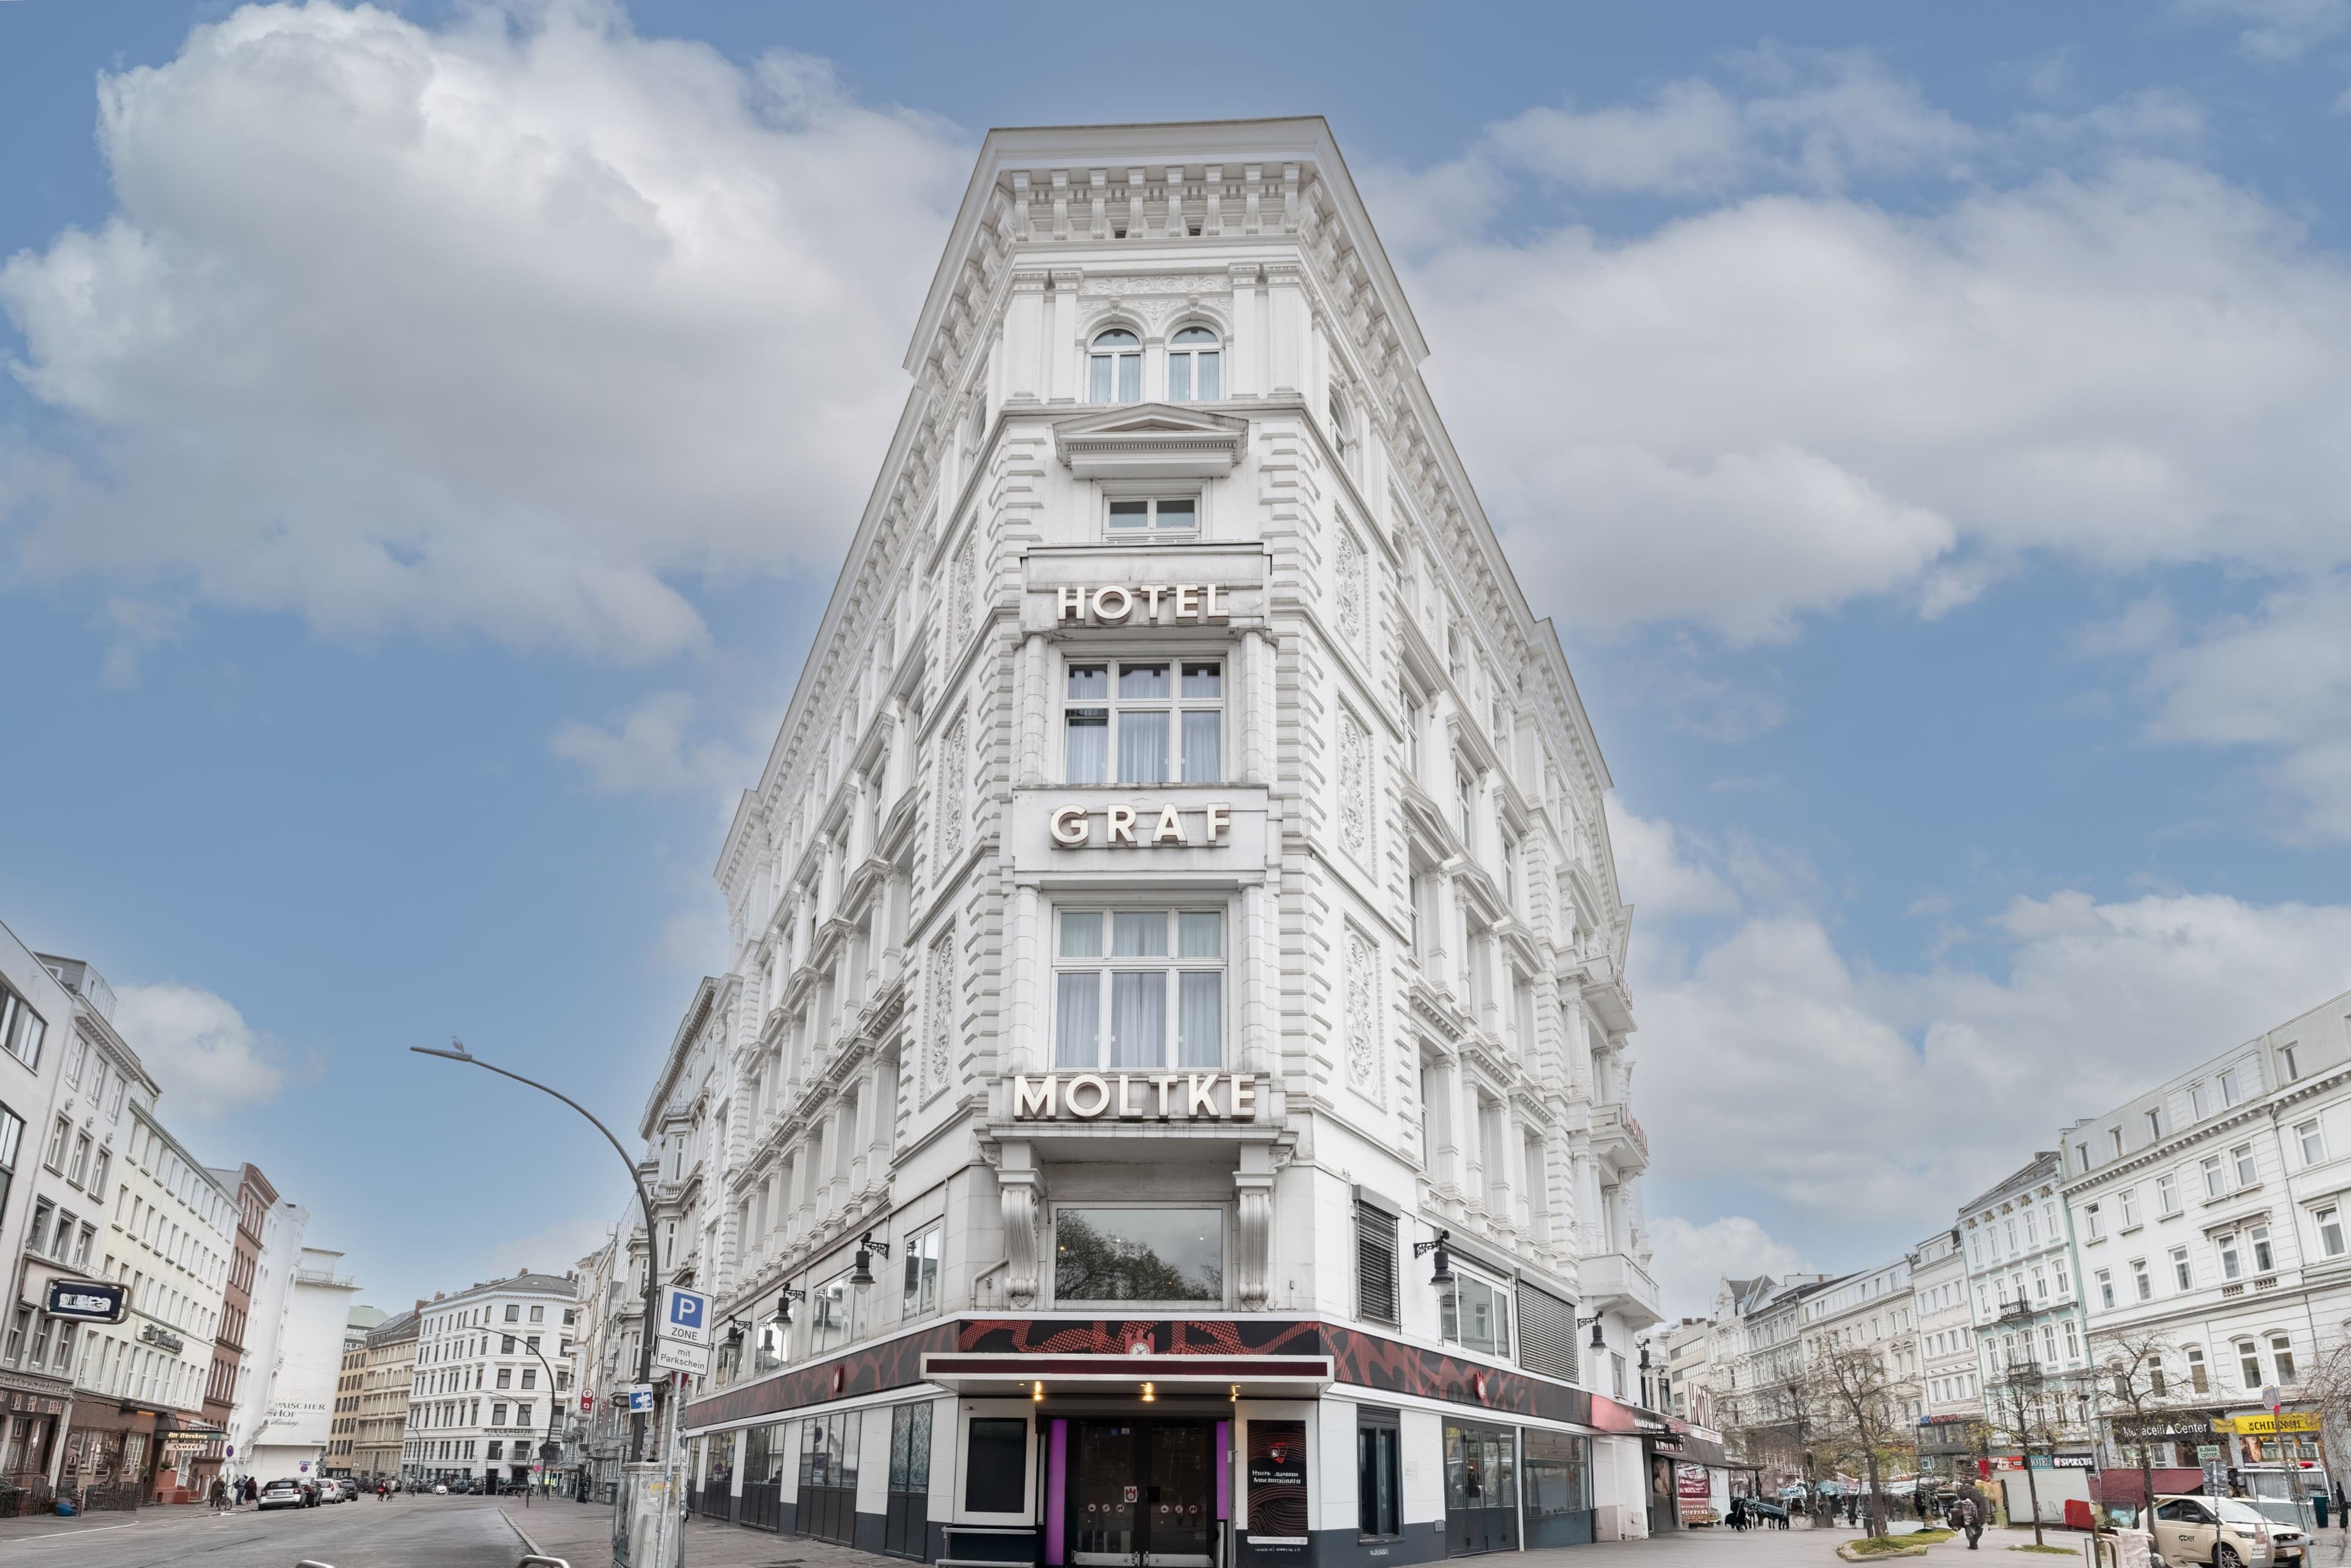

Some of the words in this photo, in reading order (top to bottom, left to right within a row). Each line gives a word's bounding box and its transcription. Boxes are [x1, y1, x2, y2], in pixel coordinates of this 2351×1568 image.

[1057, 583, 1230, 626] HOTEL
[1049, 802, 1230, 847] GRAF
[1014, 1074, 1256, 1120] MOLTKE
[678, 1297, 696, 1321] P
[2000, 1304, 2020, 1316] HOTEL
[671, 1327, 698, 1341] ZONE
[661, 1353, 705, 1370] Parkschein
[2175, 1422, 2208, 1434] Center
